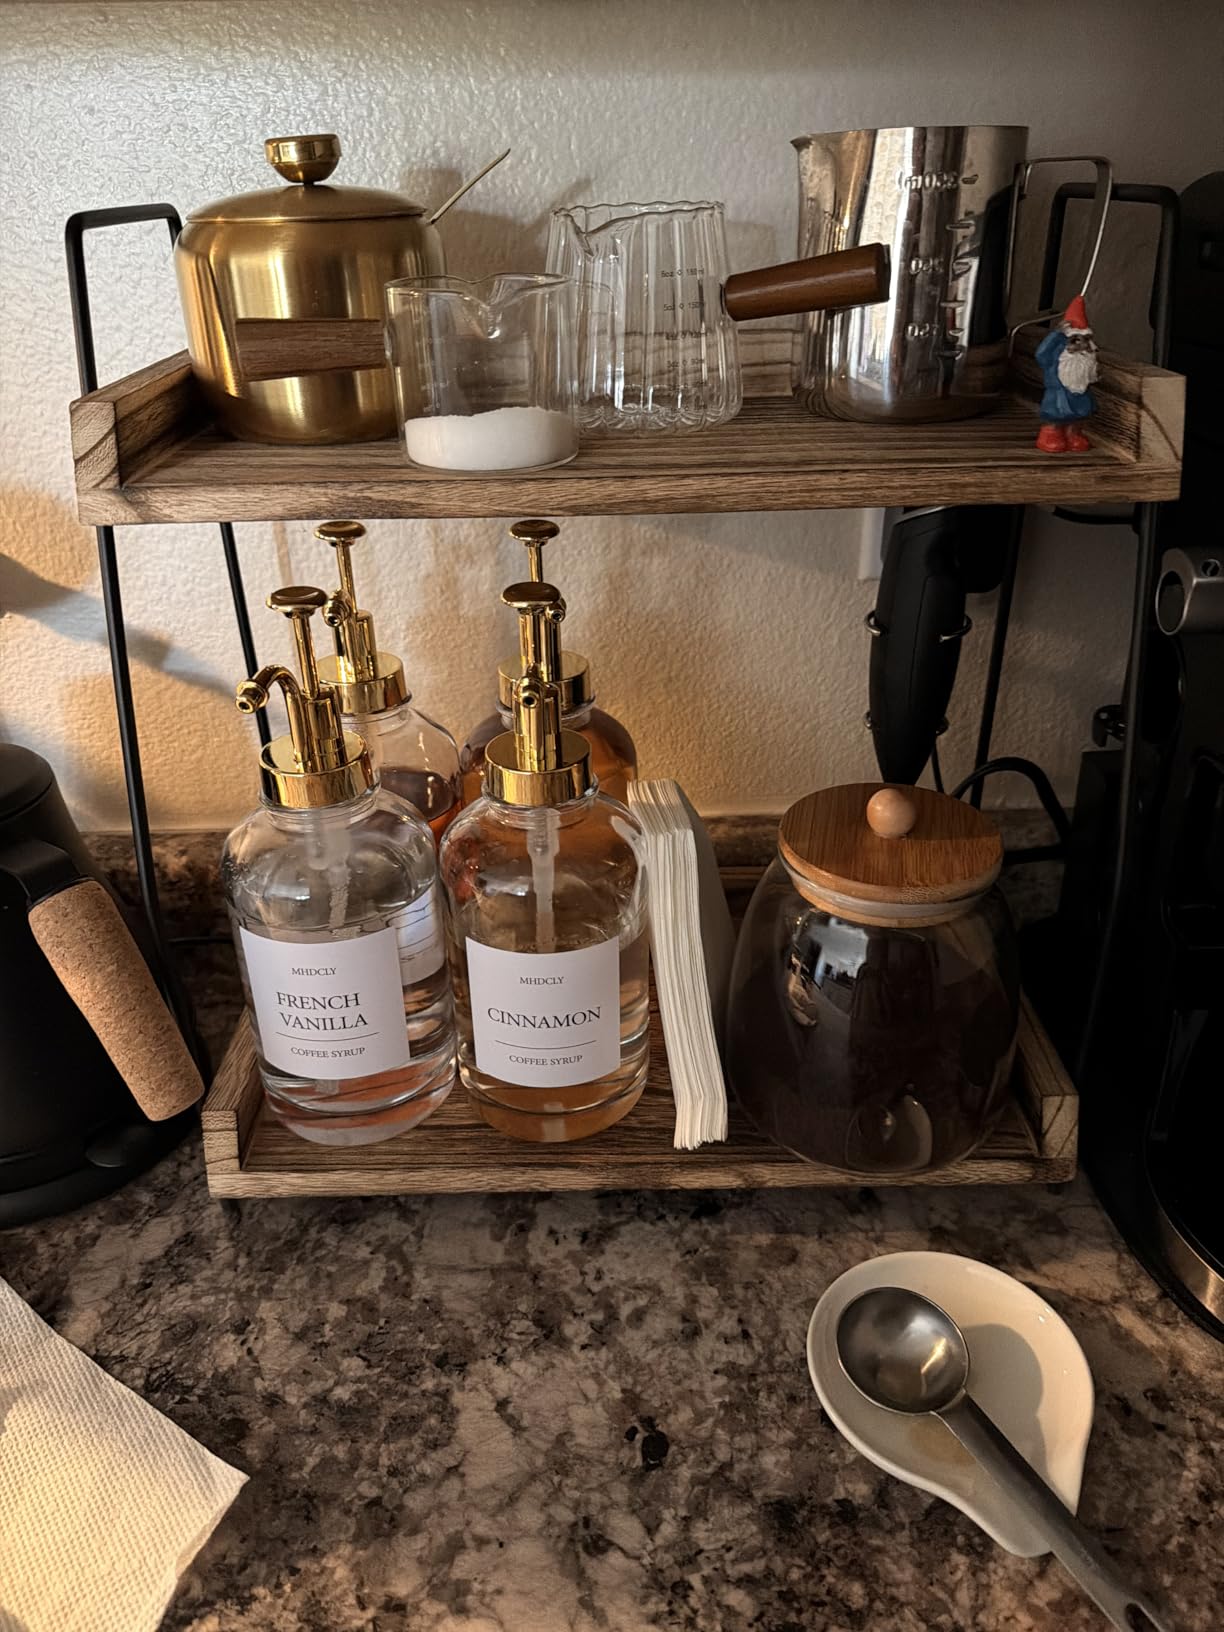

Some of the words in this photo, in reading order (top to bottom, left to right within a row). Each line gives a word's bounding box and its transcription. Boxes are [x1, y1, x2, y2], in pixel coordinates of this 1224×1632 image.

[291, 967, 337, 977] MHDCLY
[519, 976, 565, 986] MHDCLY
[276, 991, 361, 1011] FRENCH
[280, 1012, 369, 1031] VANILLA
[487, 1006, 602, 1029] CINNAMON
[290, 1047, 330, 1058] COFFEE
[331, 1047, 366, 1059] SYRUP
[509, 1055, 549, 1066] COFFEE
[550, 1055, 584, 1066] SYRUP
